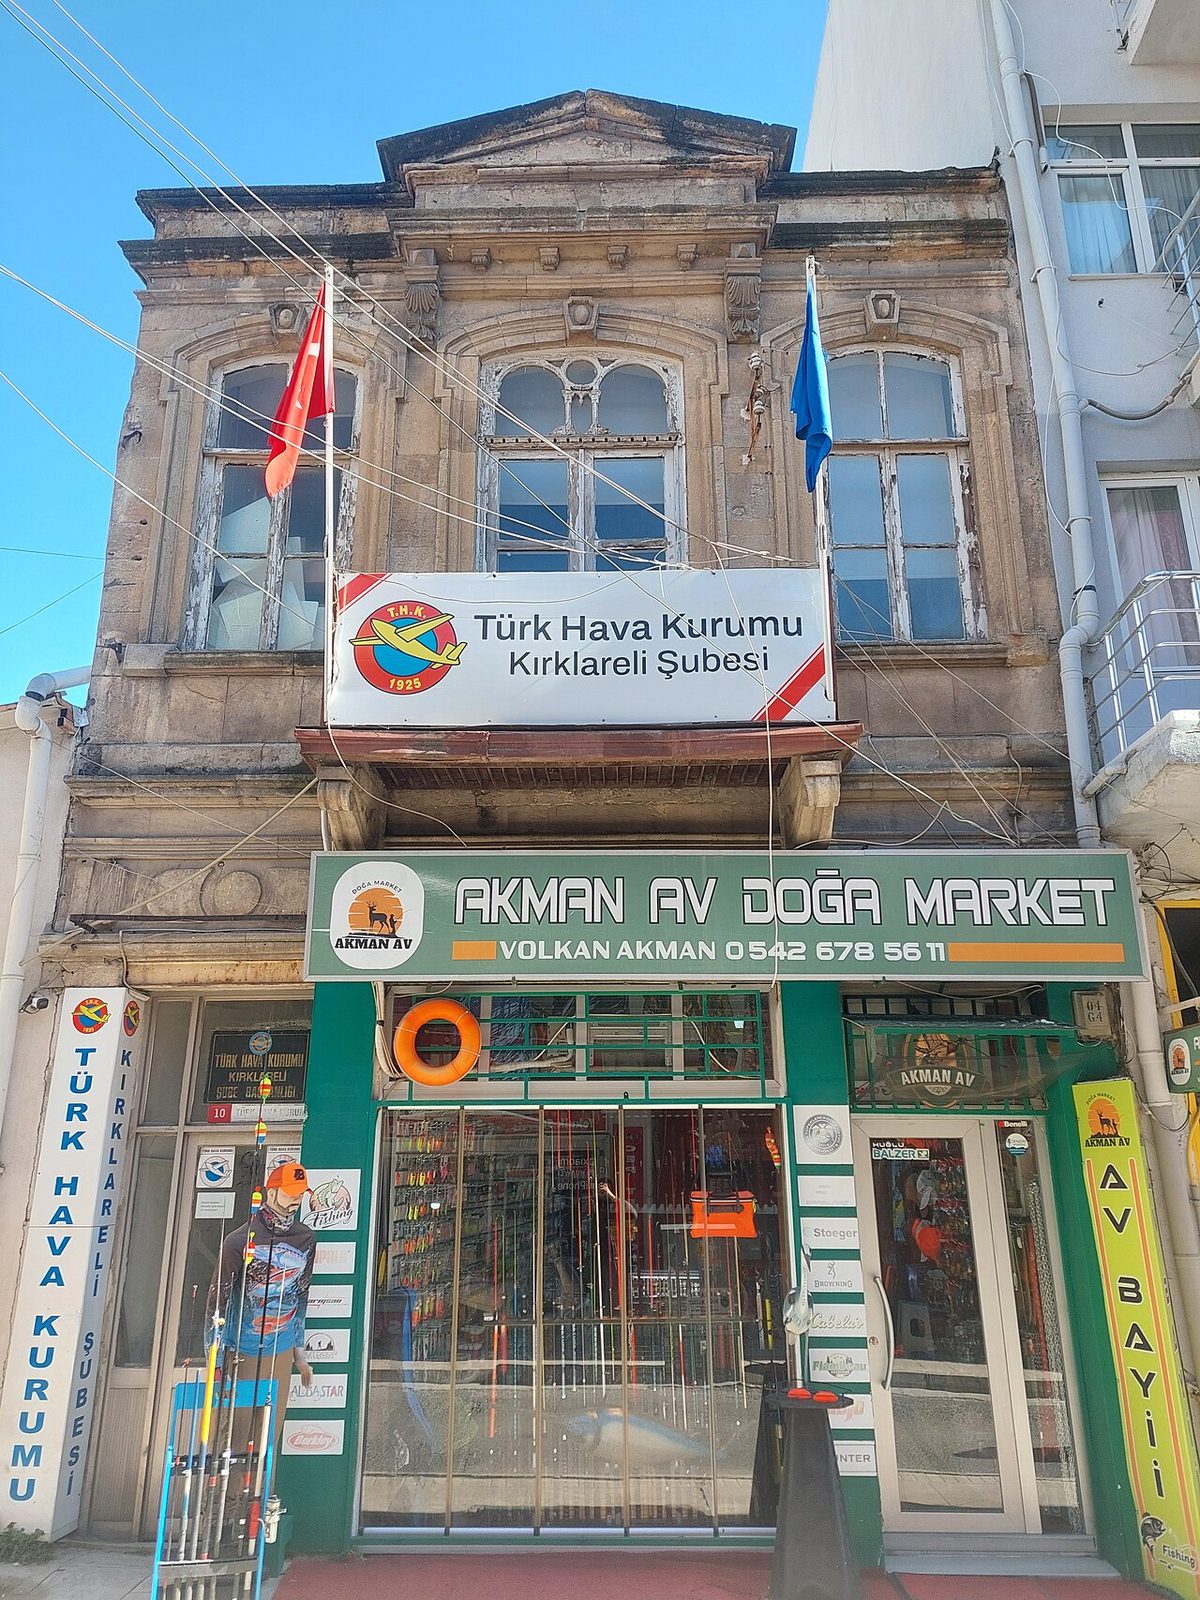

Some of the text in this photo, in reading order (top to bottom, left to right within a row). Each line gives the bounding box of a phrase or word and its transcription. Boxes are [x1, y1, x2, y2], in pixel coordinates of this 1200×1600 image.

[387, 605, 426, 618] T.H.K.
[474, 612, 803, 642] Türk Hava Kurumu
[509, 646, 769, 680] Kırklareli Şubesi
[389, 678, 422, 690] 1925
[351, 880, 402, 895] DOĞA MARKET
[454, 868, 1115, 926] AKMAN AV DOĞA MARKET
[335, 938, 413, 950] AKMAN AV
[499, 940, 612, 961] VOLKAN
[616, 940, 716, 961] AKMAN
[816, 941, 874, 961] 678
[884, 941, 921, 961] 56
[929, 941, 946, 961] 11
[214, 1053, 238, 1068] TÜRK
[267, 1053, 304, 1068] KURUMU
[901, 1069, 976, 1087] AKMAN AV
[214, 1108, 226, 1118] 10
[1085, 1138, 1130, 1148] AKMAN AV
[873, 1149, 916, 1159] BALZER
[1099, 1164, 1132, 1234] AV
[311, 1209, 353, 1228] Fishing
[813, 1228, 858, 1240] Stoeger
[8, 1048, 97, 1501] TÜRK HAVA KURUMU
[814, 1280, 852, 1288] BROWNING
[810, 1312, 865, 1329] Cabela's
[1162, 1545, 1196, 1569] Fishing
